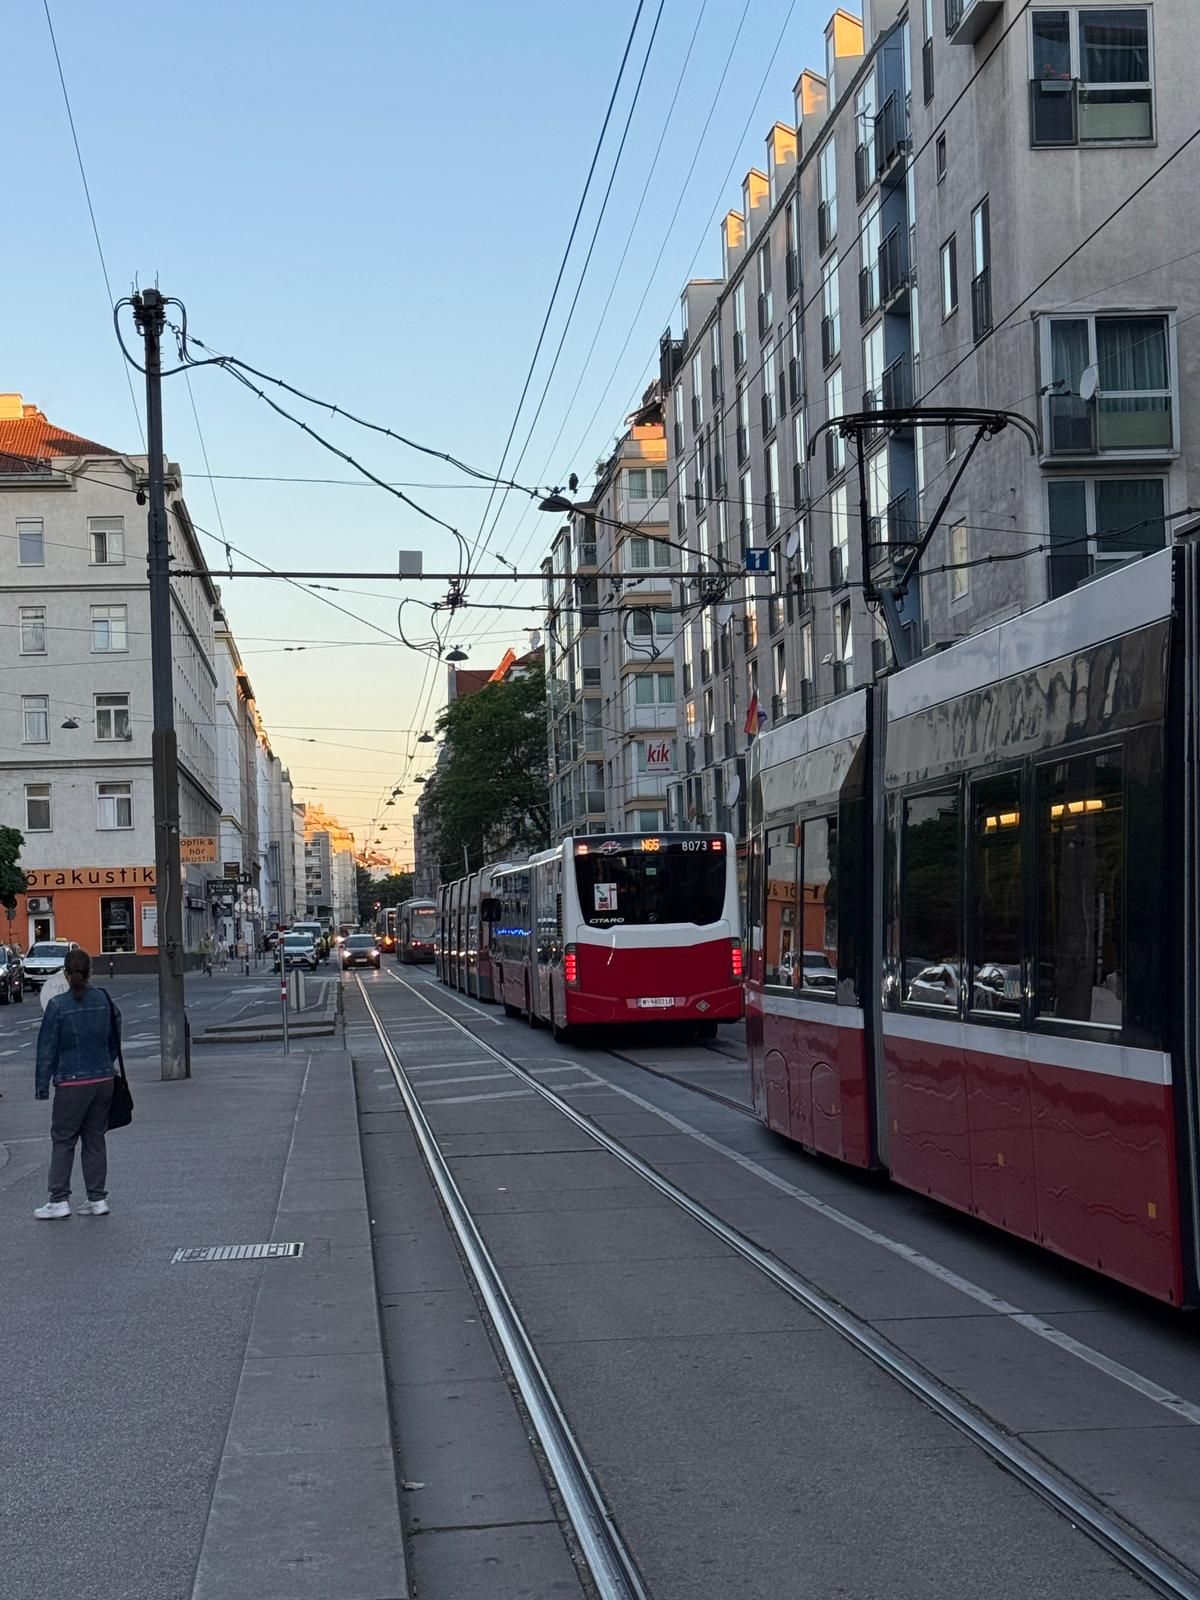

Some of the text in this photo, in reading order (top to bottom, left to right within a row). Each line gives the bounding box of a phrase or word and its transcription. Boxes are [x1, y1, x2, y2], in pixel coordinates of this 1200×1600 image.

[750, 550, 766, 568] T
[180, 839, 205, 847] optik
[641, 839, 707, 851] N65 8073
